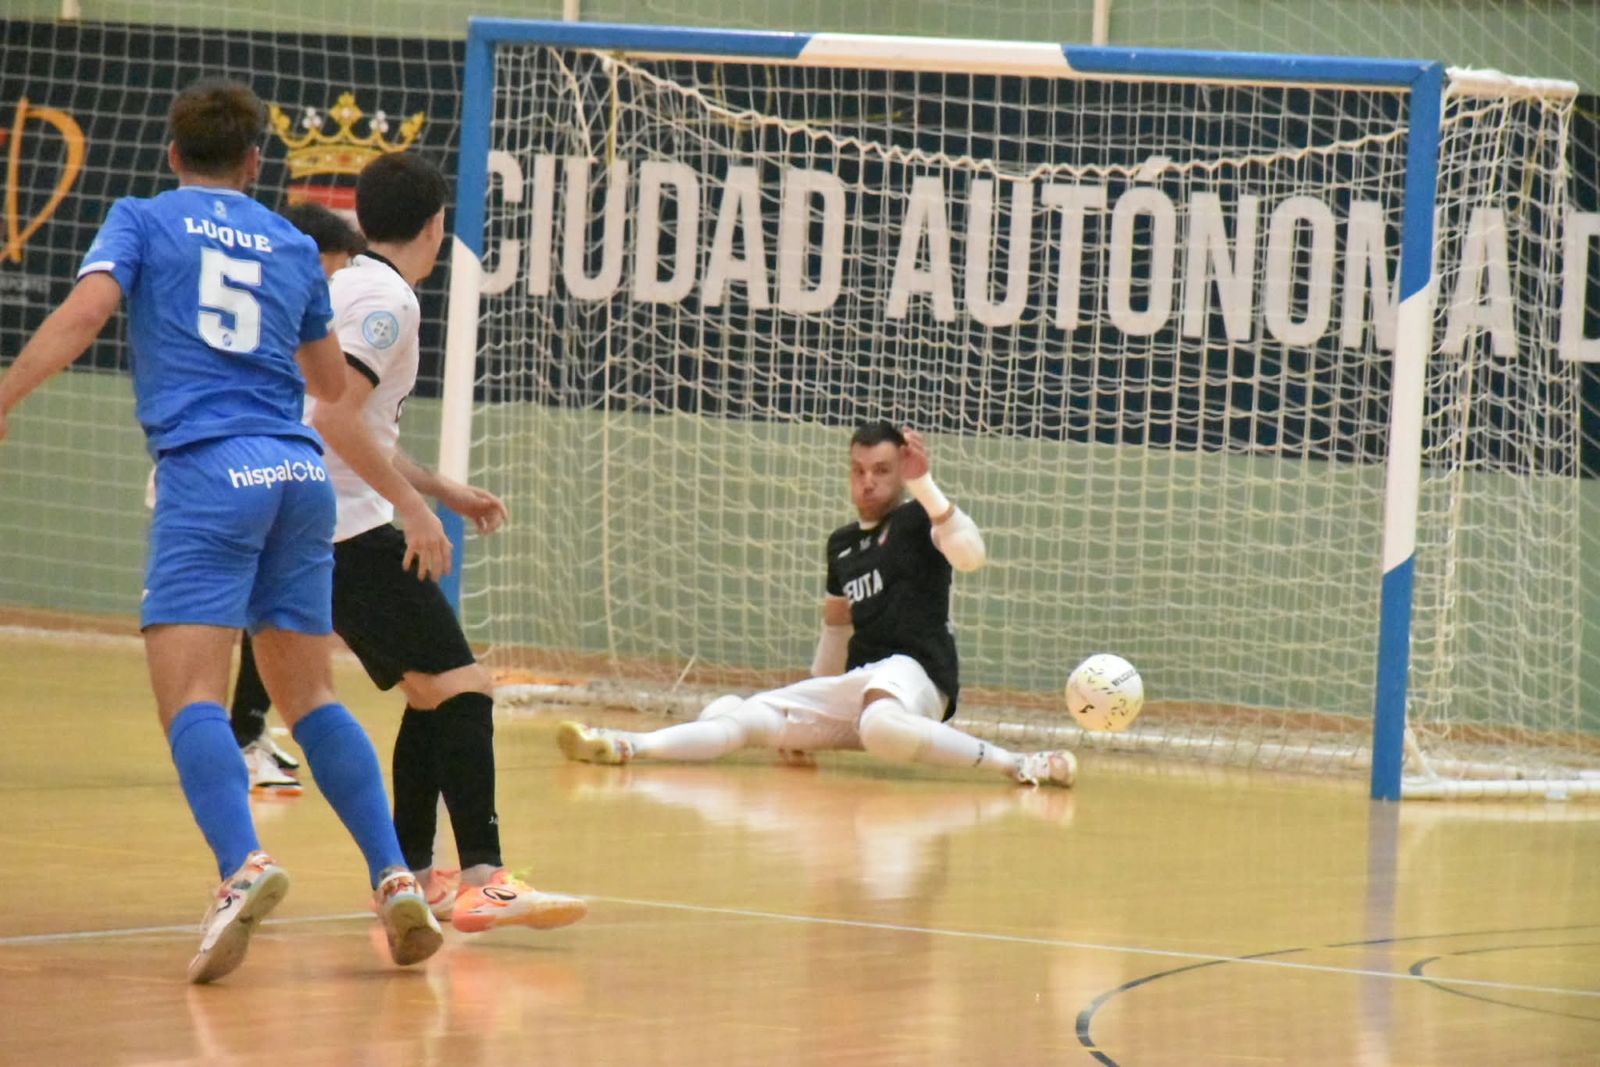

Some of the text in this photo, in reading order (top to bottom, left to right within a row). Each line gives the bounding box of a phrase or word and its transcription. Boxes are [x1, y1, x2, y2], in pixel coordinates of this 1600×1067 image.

[183, 217, 273, 253] LUQUE
[479, 150, 847, 315] CIUDAD
[198, 246, 262, 353] 5
[228, 459, 326, 489] hispaloto
[842, 568, 883, 604] EUTA
